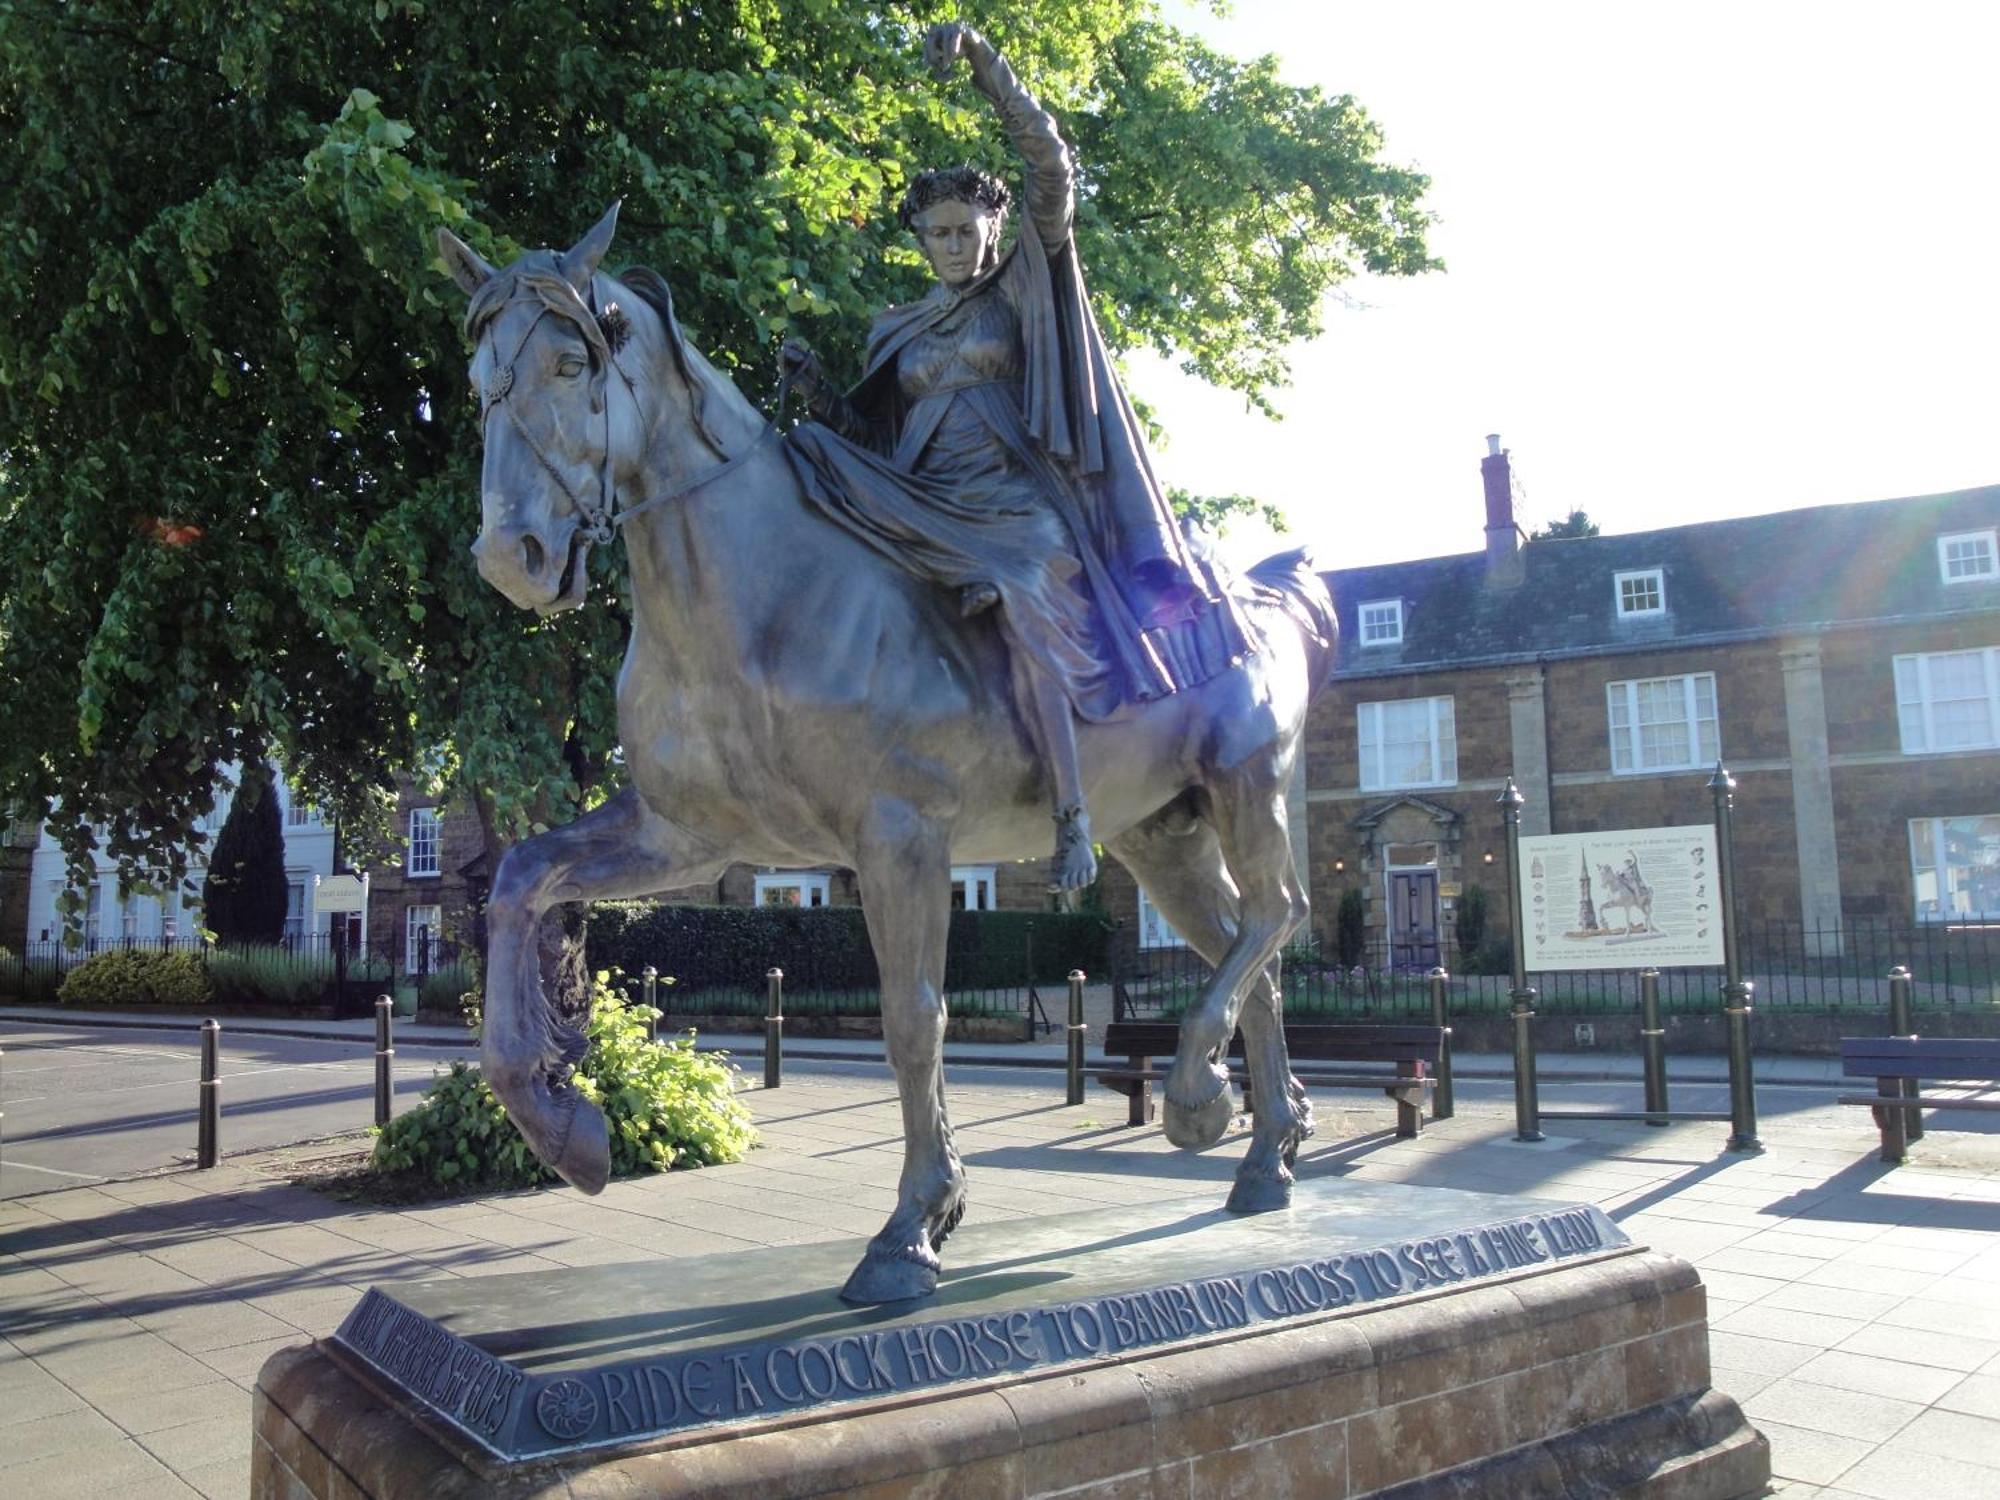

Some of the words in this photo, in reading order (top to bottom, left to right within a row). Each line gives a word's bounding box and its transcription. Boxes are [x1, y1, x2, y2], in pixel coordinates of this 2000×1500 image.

[434, 1343, 480, 1412] SHE
[463, 1358, 522, 1436] GOES
[599, 1360, 720, 1433] RIDE
[724, 1352, 764, 1410] A
[767, 1332, 896, 1403] COCK
[897, 1311, 1041, 1382] HORSE
[1041, 1301, 1106, 1356] TO
[1105, 1278, 1250, 1346] BANBURY
[1256, 1259, 1358, 1315] CROSS
[1358, 1249, 1405, 1294] TO
[1401, 1238, 1464, 1284] SEE
[1457, 1233, 1490, 1278] A
[1483, 1221, 1548, 1270] FINE
[1543, 1208, 1602, 1257] LADY
